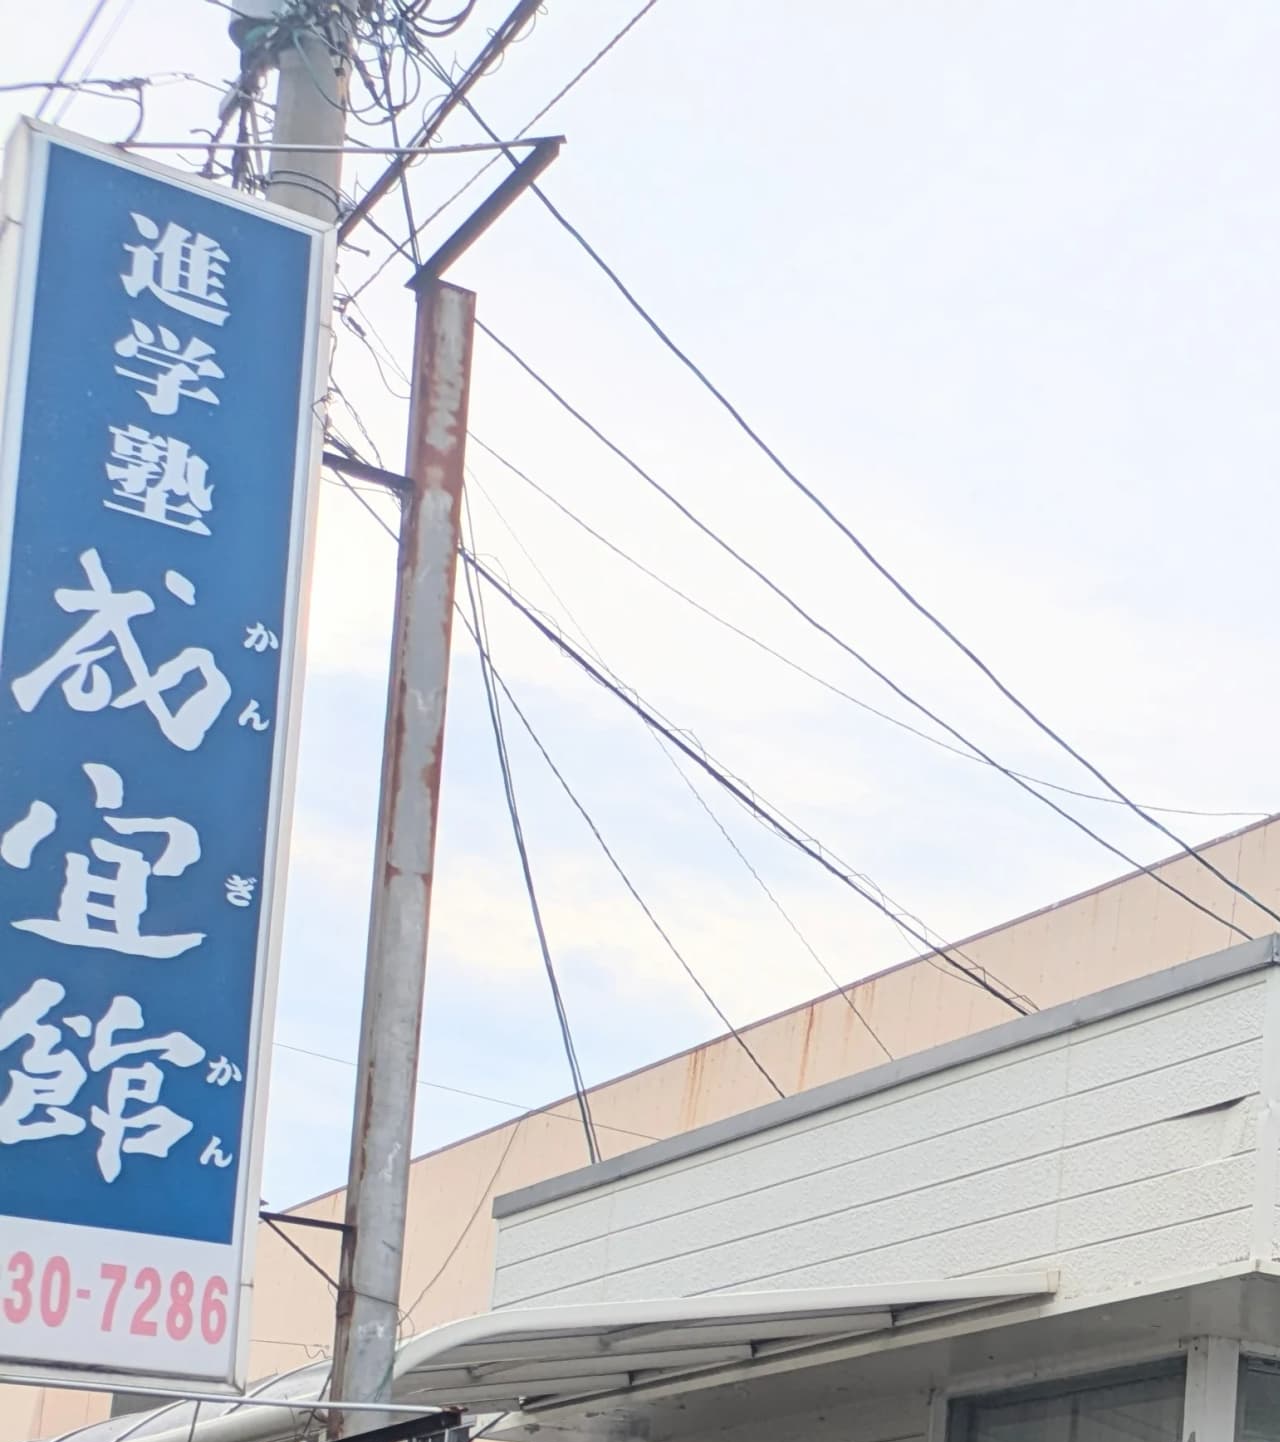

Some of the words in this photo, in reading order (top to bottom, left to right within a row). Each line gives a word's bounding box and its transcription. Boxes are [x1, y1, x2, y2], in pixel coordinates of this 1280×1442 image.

[103, 212, 231, 536] 進学塾
[238, 621, 279, 732] かん
[225, 874, 258, 908] ぎ
[200, 1055, 242, 1169] かん
[2, 1250, 229, 1346] 30-7286
